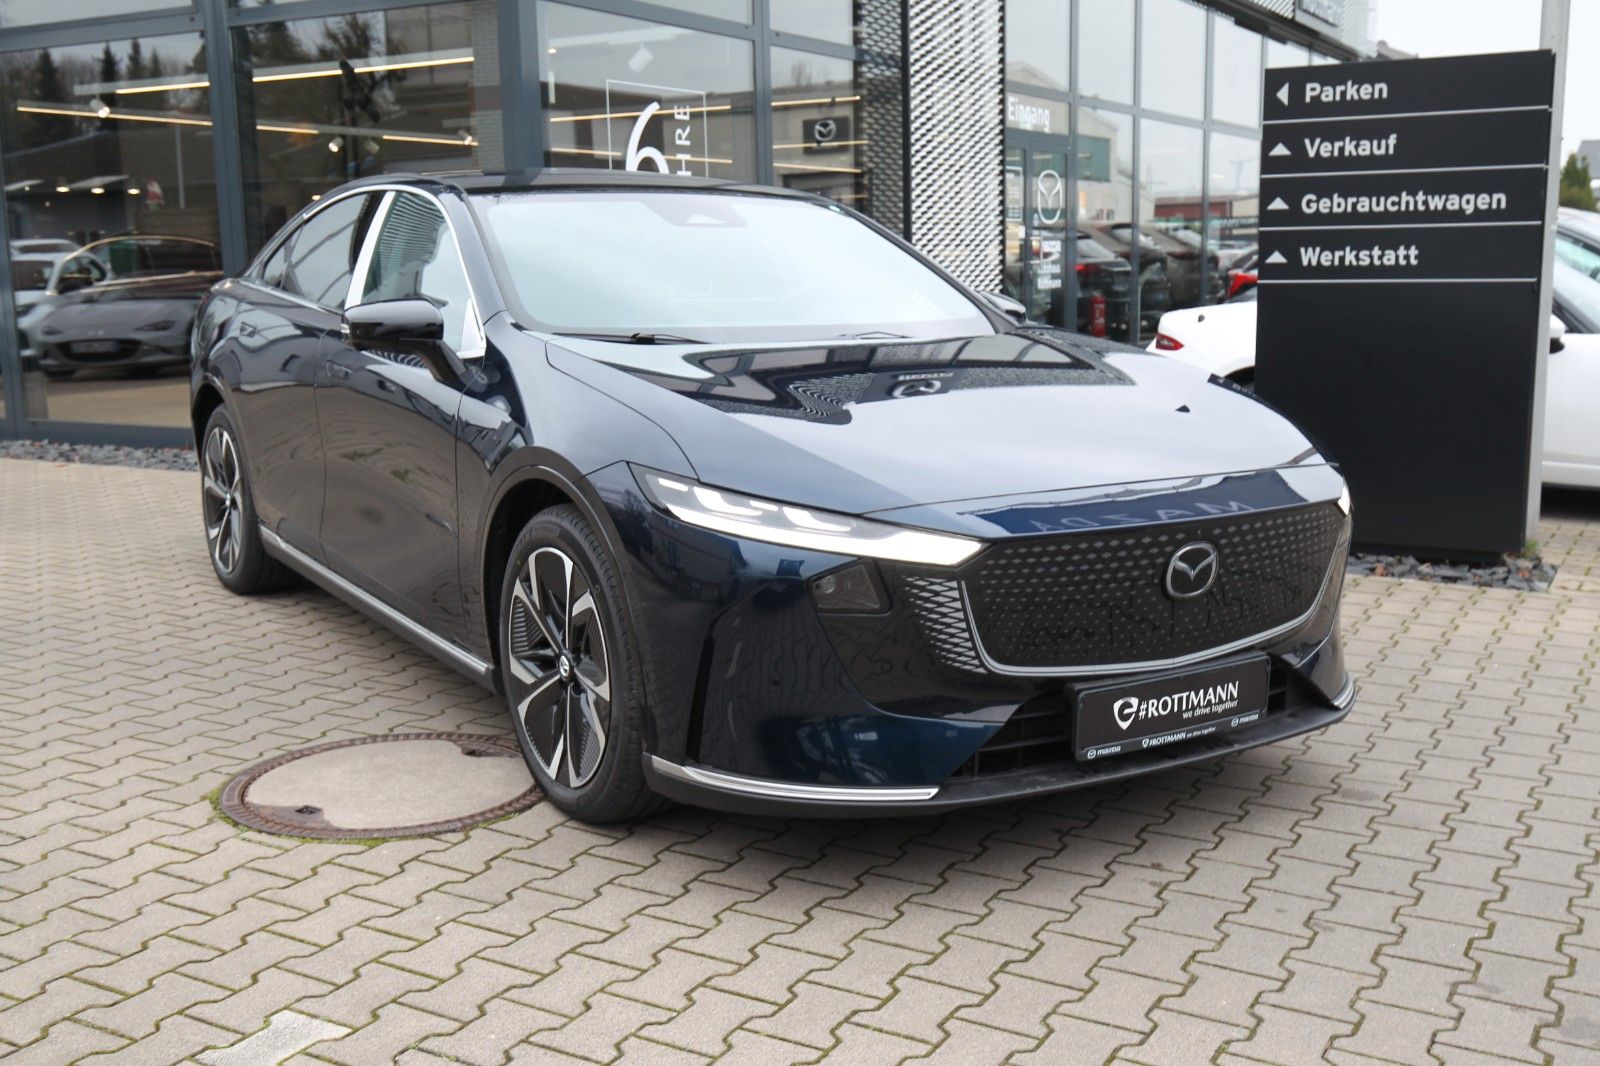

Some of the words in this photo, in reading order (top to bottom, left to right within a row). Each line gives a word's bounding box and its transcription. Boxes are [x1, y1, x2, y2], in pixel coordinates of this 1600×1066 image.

[1305, 80, 1388, 104] Parken
[1007, 96, 1052, 134] Eingang
[1304, 133, 1398, 158] Verkauf
[1301, 191, 1507, 215] Gebrauchtwagen
[1300, 244, 1419, 267] Werkstatt
[1139, 680, 1239, 720] #ROTTMANN
[1182, 709, 1193, 719] we
[1194, 705, 1211, 716] drive
[1212, 699, 1239, 713] together
